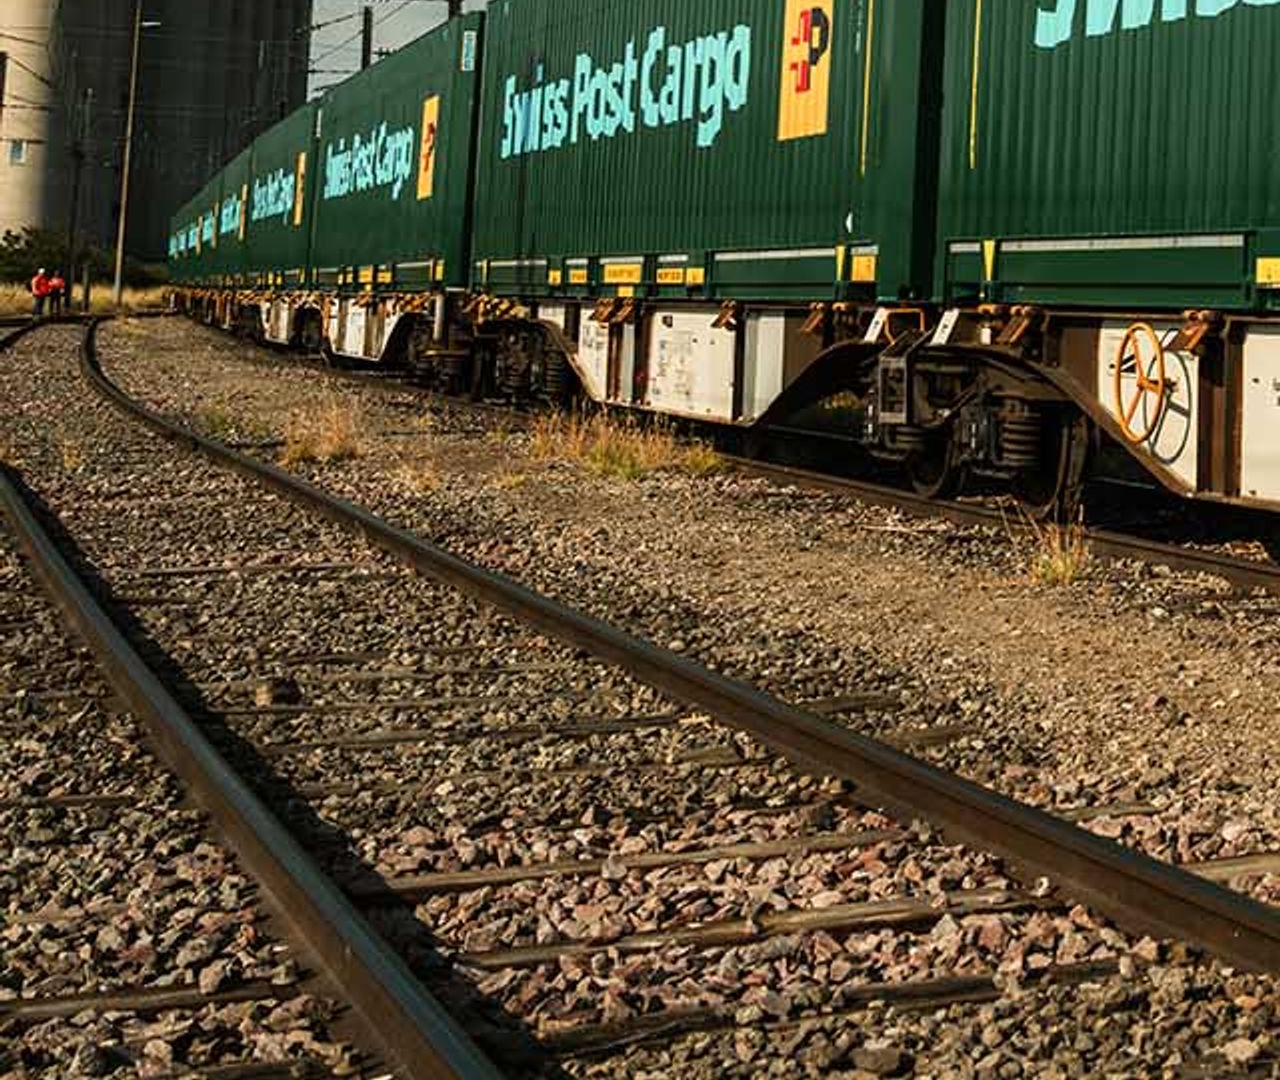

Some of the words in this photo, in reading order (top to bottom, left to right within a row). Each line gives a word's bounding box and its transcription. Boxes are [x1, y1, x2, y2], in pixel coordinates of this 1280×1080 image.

[501, 63, 570, 159] Swiss
[570, 36, 637, 144] Post
[640, 24, 750, 147] Cargo
